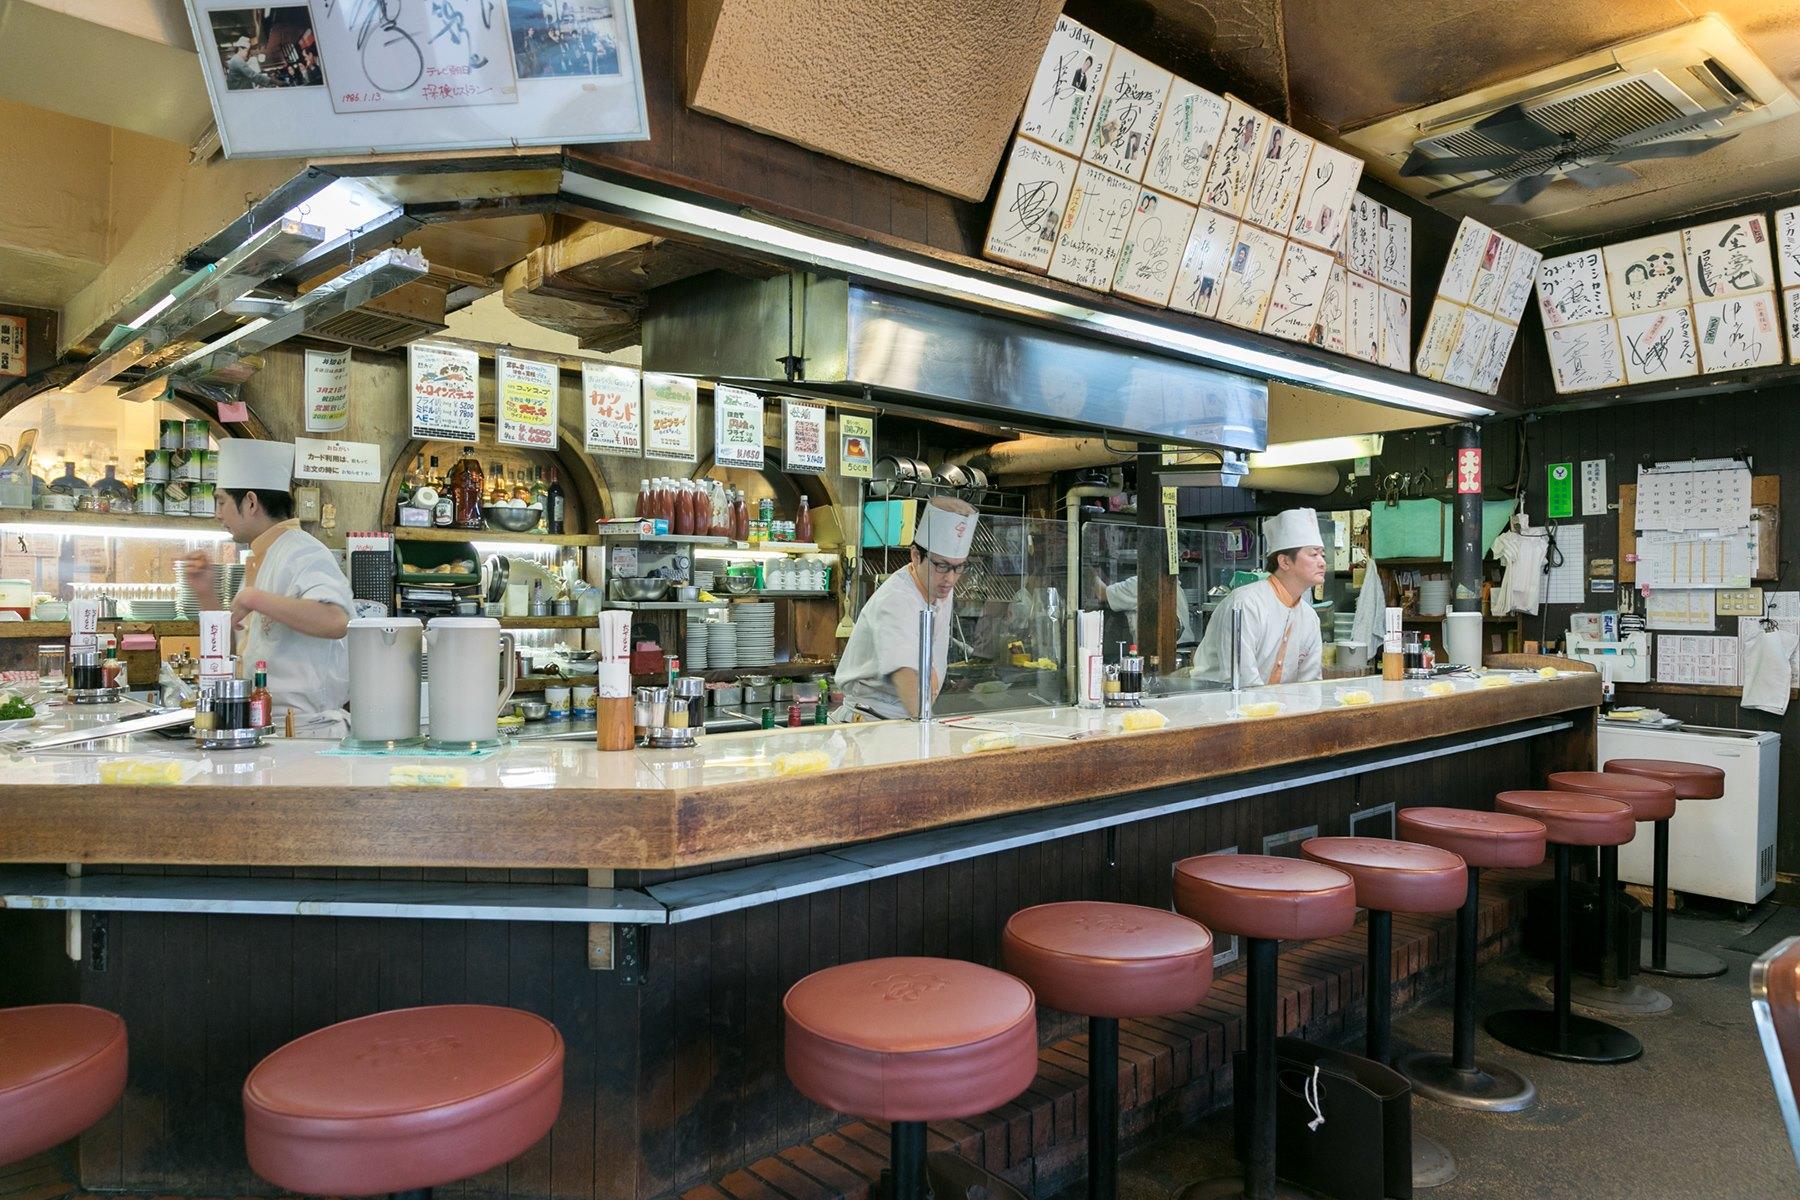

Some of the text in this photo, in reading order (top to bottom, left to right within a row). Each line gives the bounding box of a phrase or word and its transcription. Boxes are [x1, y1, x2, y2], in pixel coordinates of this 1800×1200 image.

[415, 384, 474, 400] サーロインステーキ
[589, 390, 621, 406] カツ
[598, 402, 636, 421] サンド
[303, 465, 339, 474] 注文の時に
[848, 463, 868, 471] 500円
